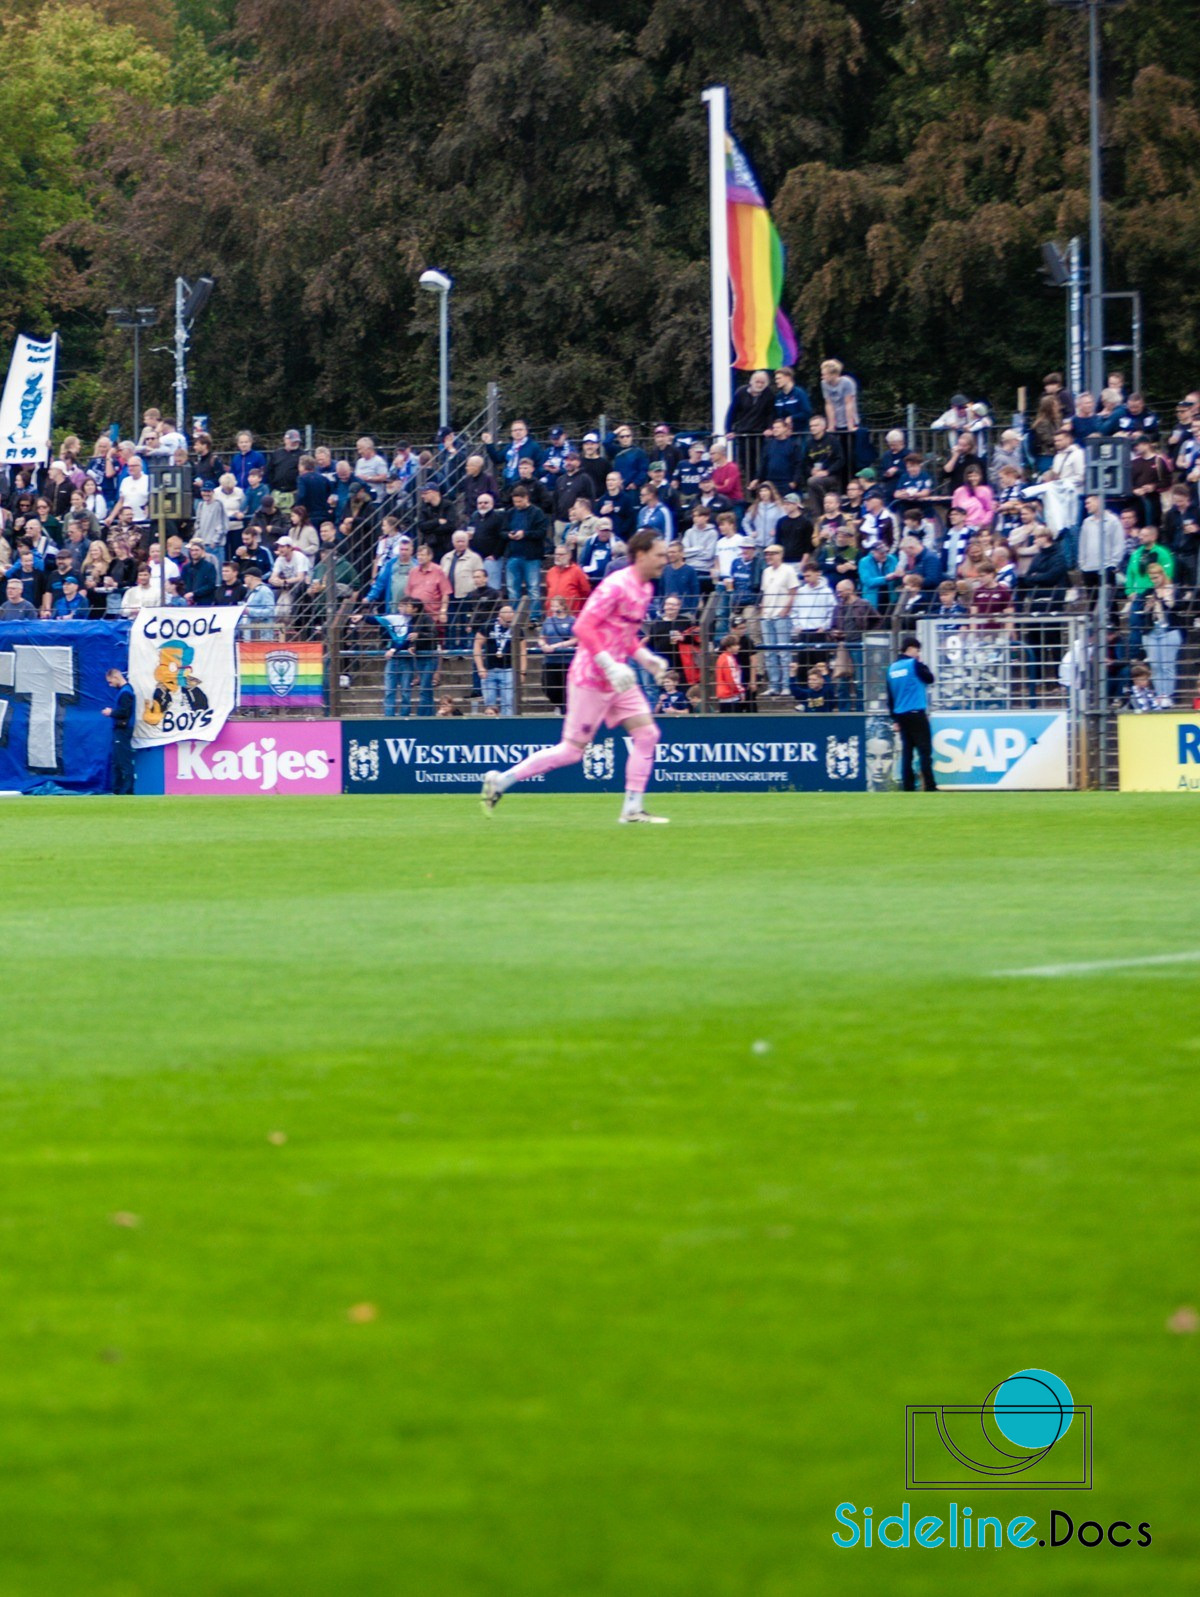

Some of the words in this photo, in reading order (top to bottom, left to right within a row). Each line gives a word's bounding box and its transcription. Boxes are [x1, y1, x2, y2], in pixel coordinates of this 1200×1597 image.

[21, 447, 37, 459] 99
[143, 614, 222, 639] COOOL
[162, 709, 214, 733] BOYS
[384, 738, 555, 765] WESTMINST
[622, 736, 818, 763] ESTMINSTER
[932, 728, 1027, 774] SAP
[176, 738, 329, 790] Katjes
[654, 769, 788, 782] UNTERNEHMENSGRUPPE
